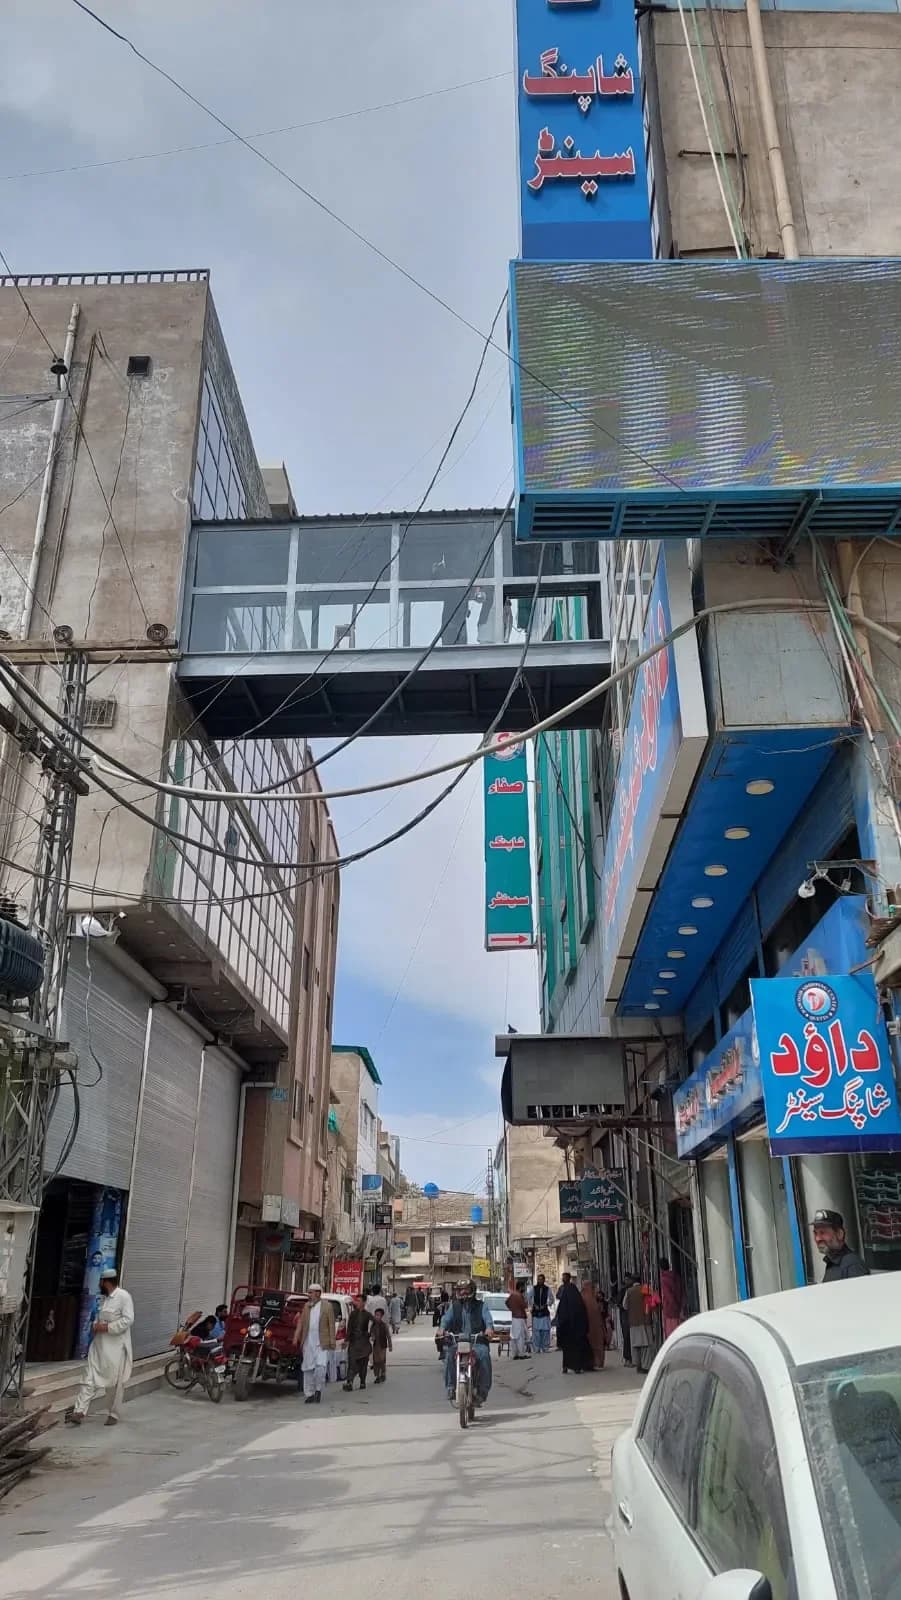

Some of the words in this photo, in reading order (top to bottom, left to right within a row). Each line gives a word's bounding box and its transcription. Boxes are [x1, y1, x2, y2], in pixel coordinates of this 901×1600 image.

[524, 48, 635, 111] شاپنگ
[527, 127, 636, 194] سینٹر
[488, 778, 525, 795] صفاء
[489, 835, 526, 853] شاپنگ
[769, 1020, 881, 1088] داؤد
[775, 1089, 824, 1133] سینٹر
[820, 1076, 892, 1130] شاپنگ
